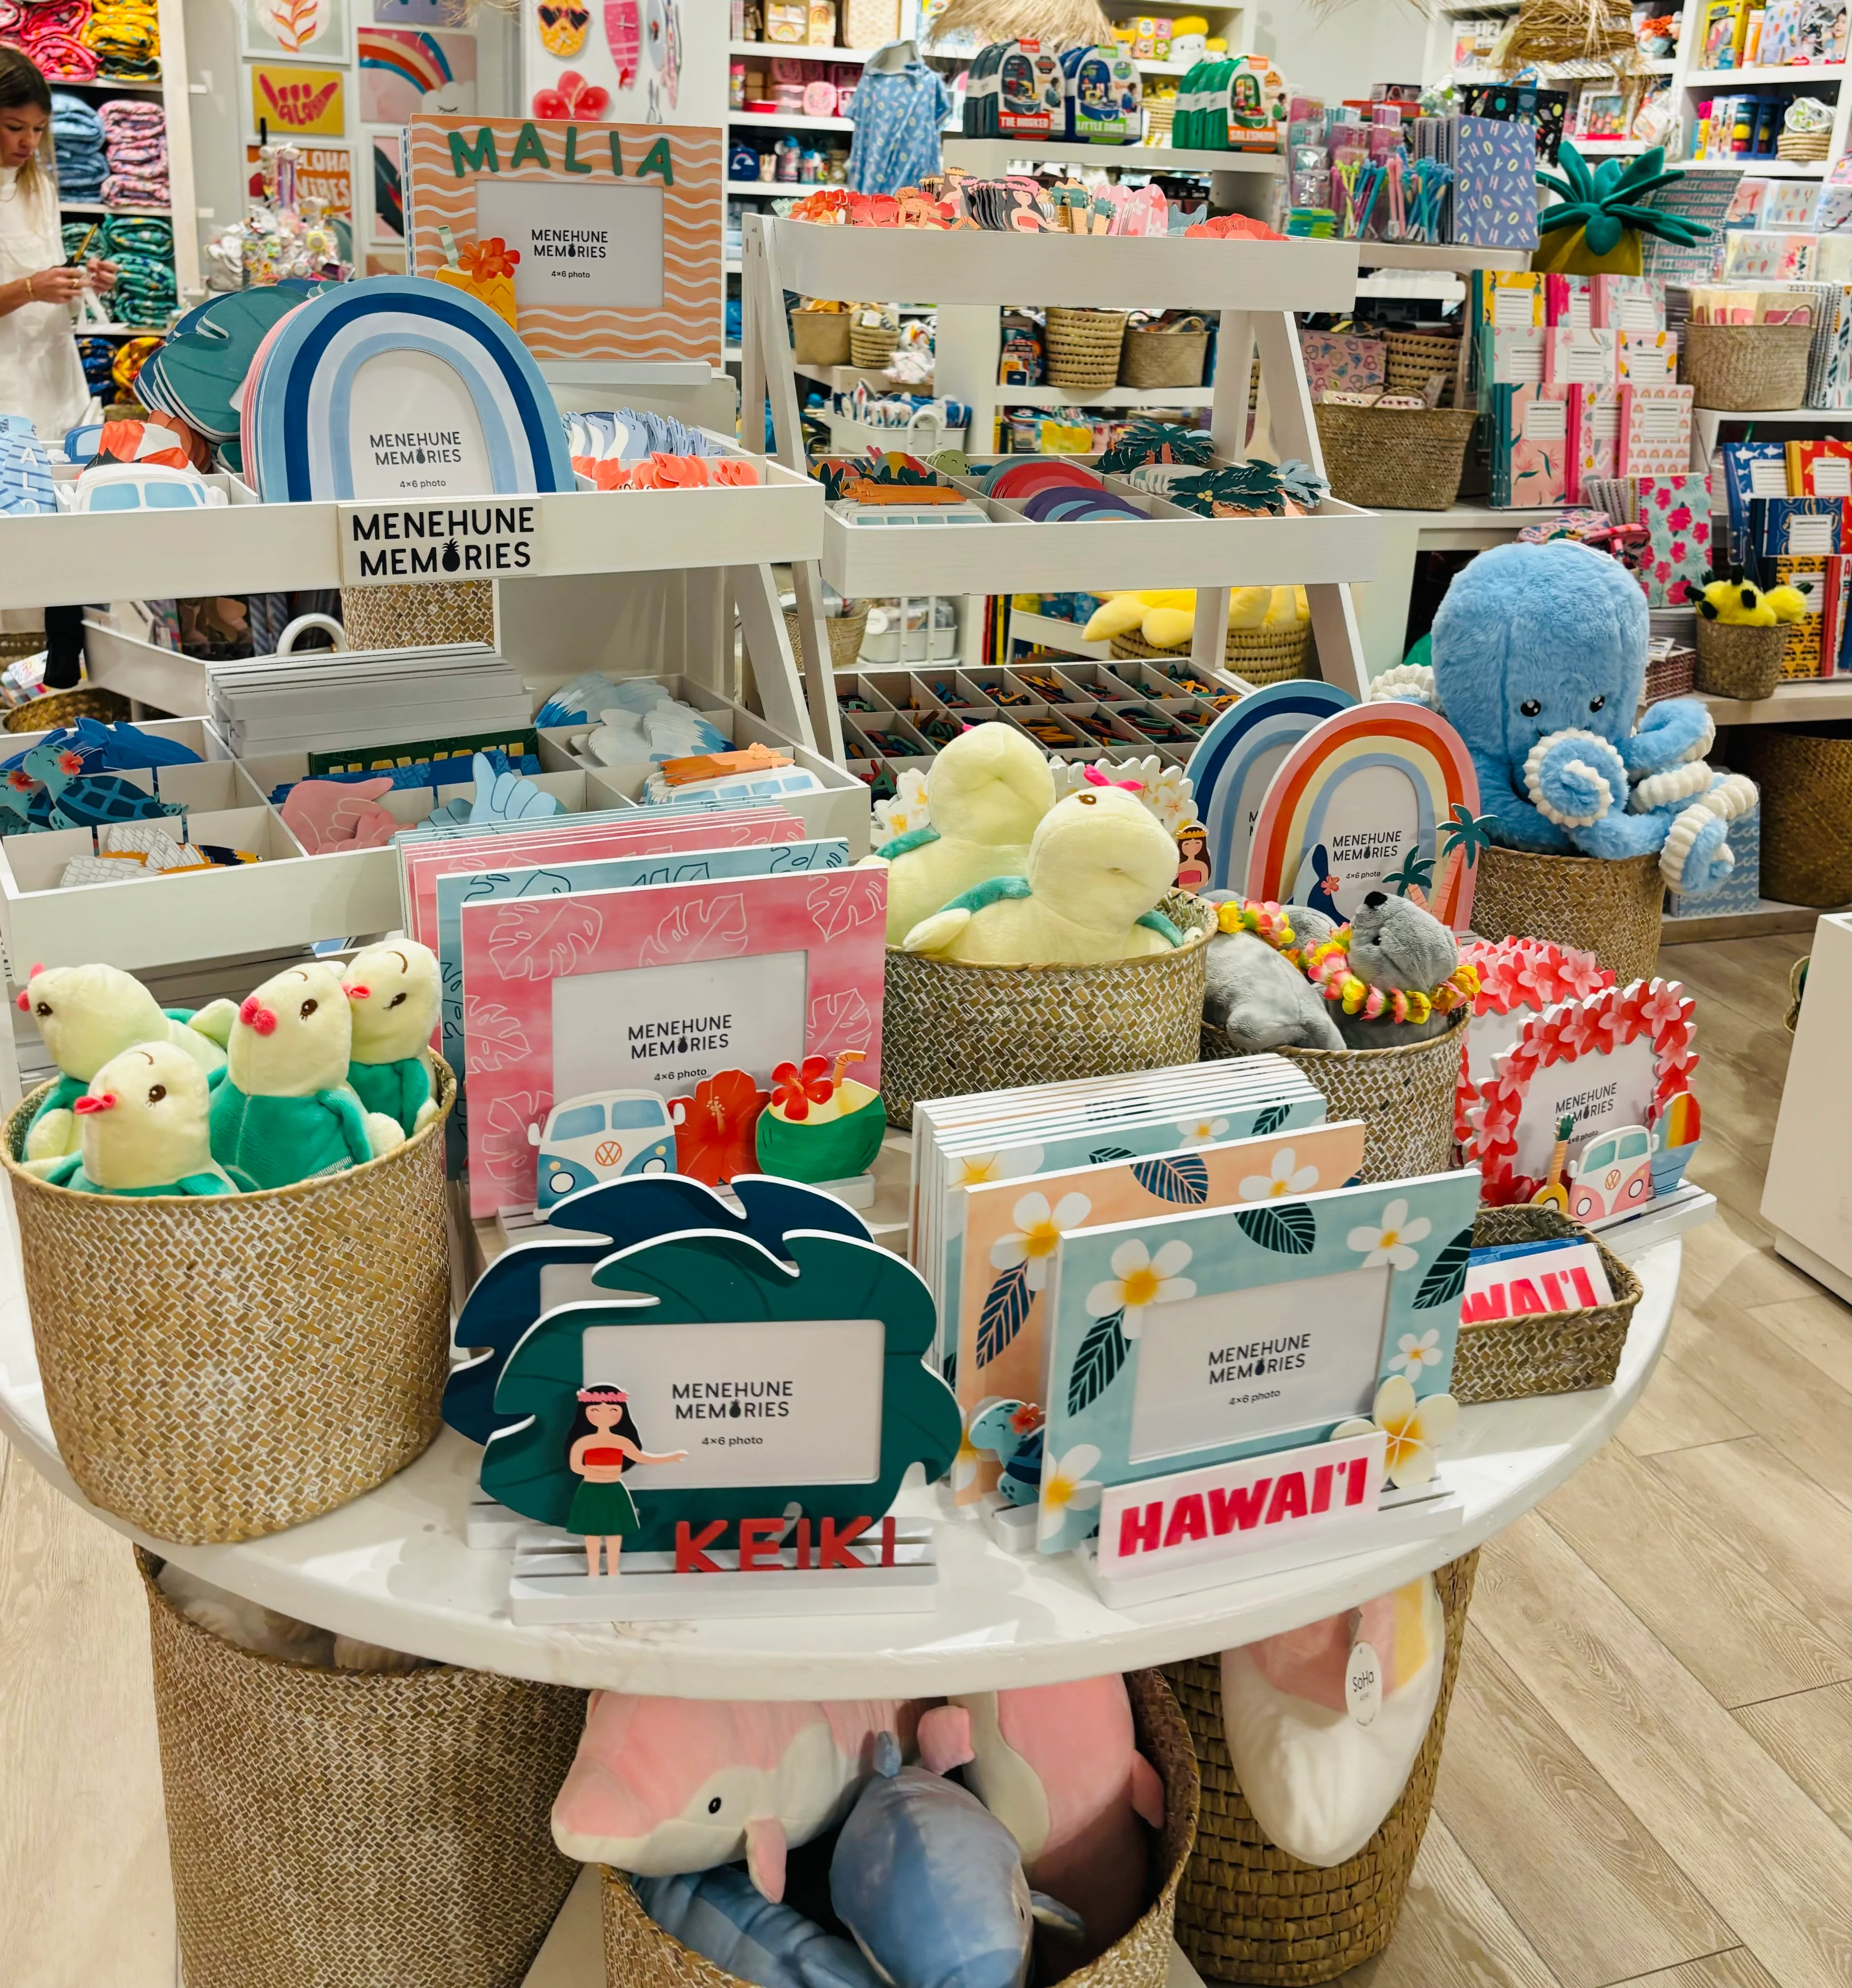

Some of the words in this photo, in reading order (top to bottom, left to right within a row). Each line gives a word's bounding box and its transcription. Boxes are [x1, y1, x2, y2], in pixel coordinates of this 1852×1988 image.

[448, 122, 673, 186] MALIA
[531, 229, 608, 243] MENEHUNE
[534, 243, 606, 259] MEMORIES
[369, 431, 461, 448] MENEHUNE
[375, 446, 461, 466] MEMORIES
[420, 480, 446, 489] photo
[353, 507, 534, 541] MENEHUNE
[360, 538, 531, 577] MEMORIES
[1332, 831, 1402, 847] MENEHUNE
[1333, 845, 1398, 862] MEMORIES
[1361, 871, 1381, 879] photo
[628, 1014, 732, 1041] MENEHUNE
[631, 1034, 729, 1060] MEMORIES
[678, 1069, 707, 1080] photo
[1555, 1082, 1618, 1114] MENEHUNE
[1556, 1099, 1614, 1123] MORIES
[1580, 1130, 1599, 1141] photo
[1208, 1333, 1311, 1366] MENEHUNE
[1209, 1353, 1306, 1385] MEMORIES
[672, 1381, 793, 1399] MENEHUNE
[1250, 1390, 1281, 1403] photo
[675, 1399, 789, 1420] MEMORIES
[729, 1436, 763, 1447] photo
[675, 1516, 896, 1573] KEIKI
